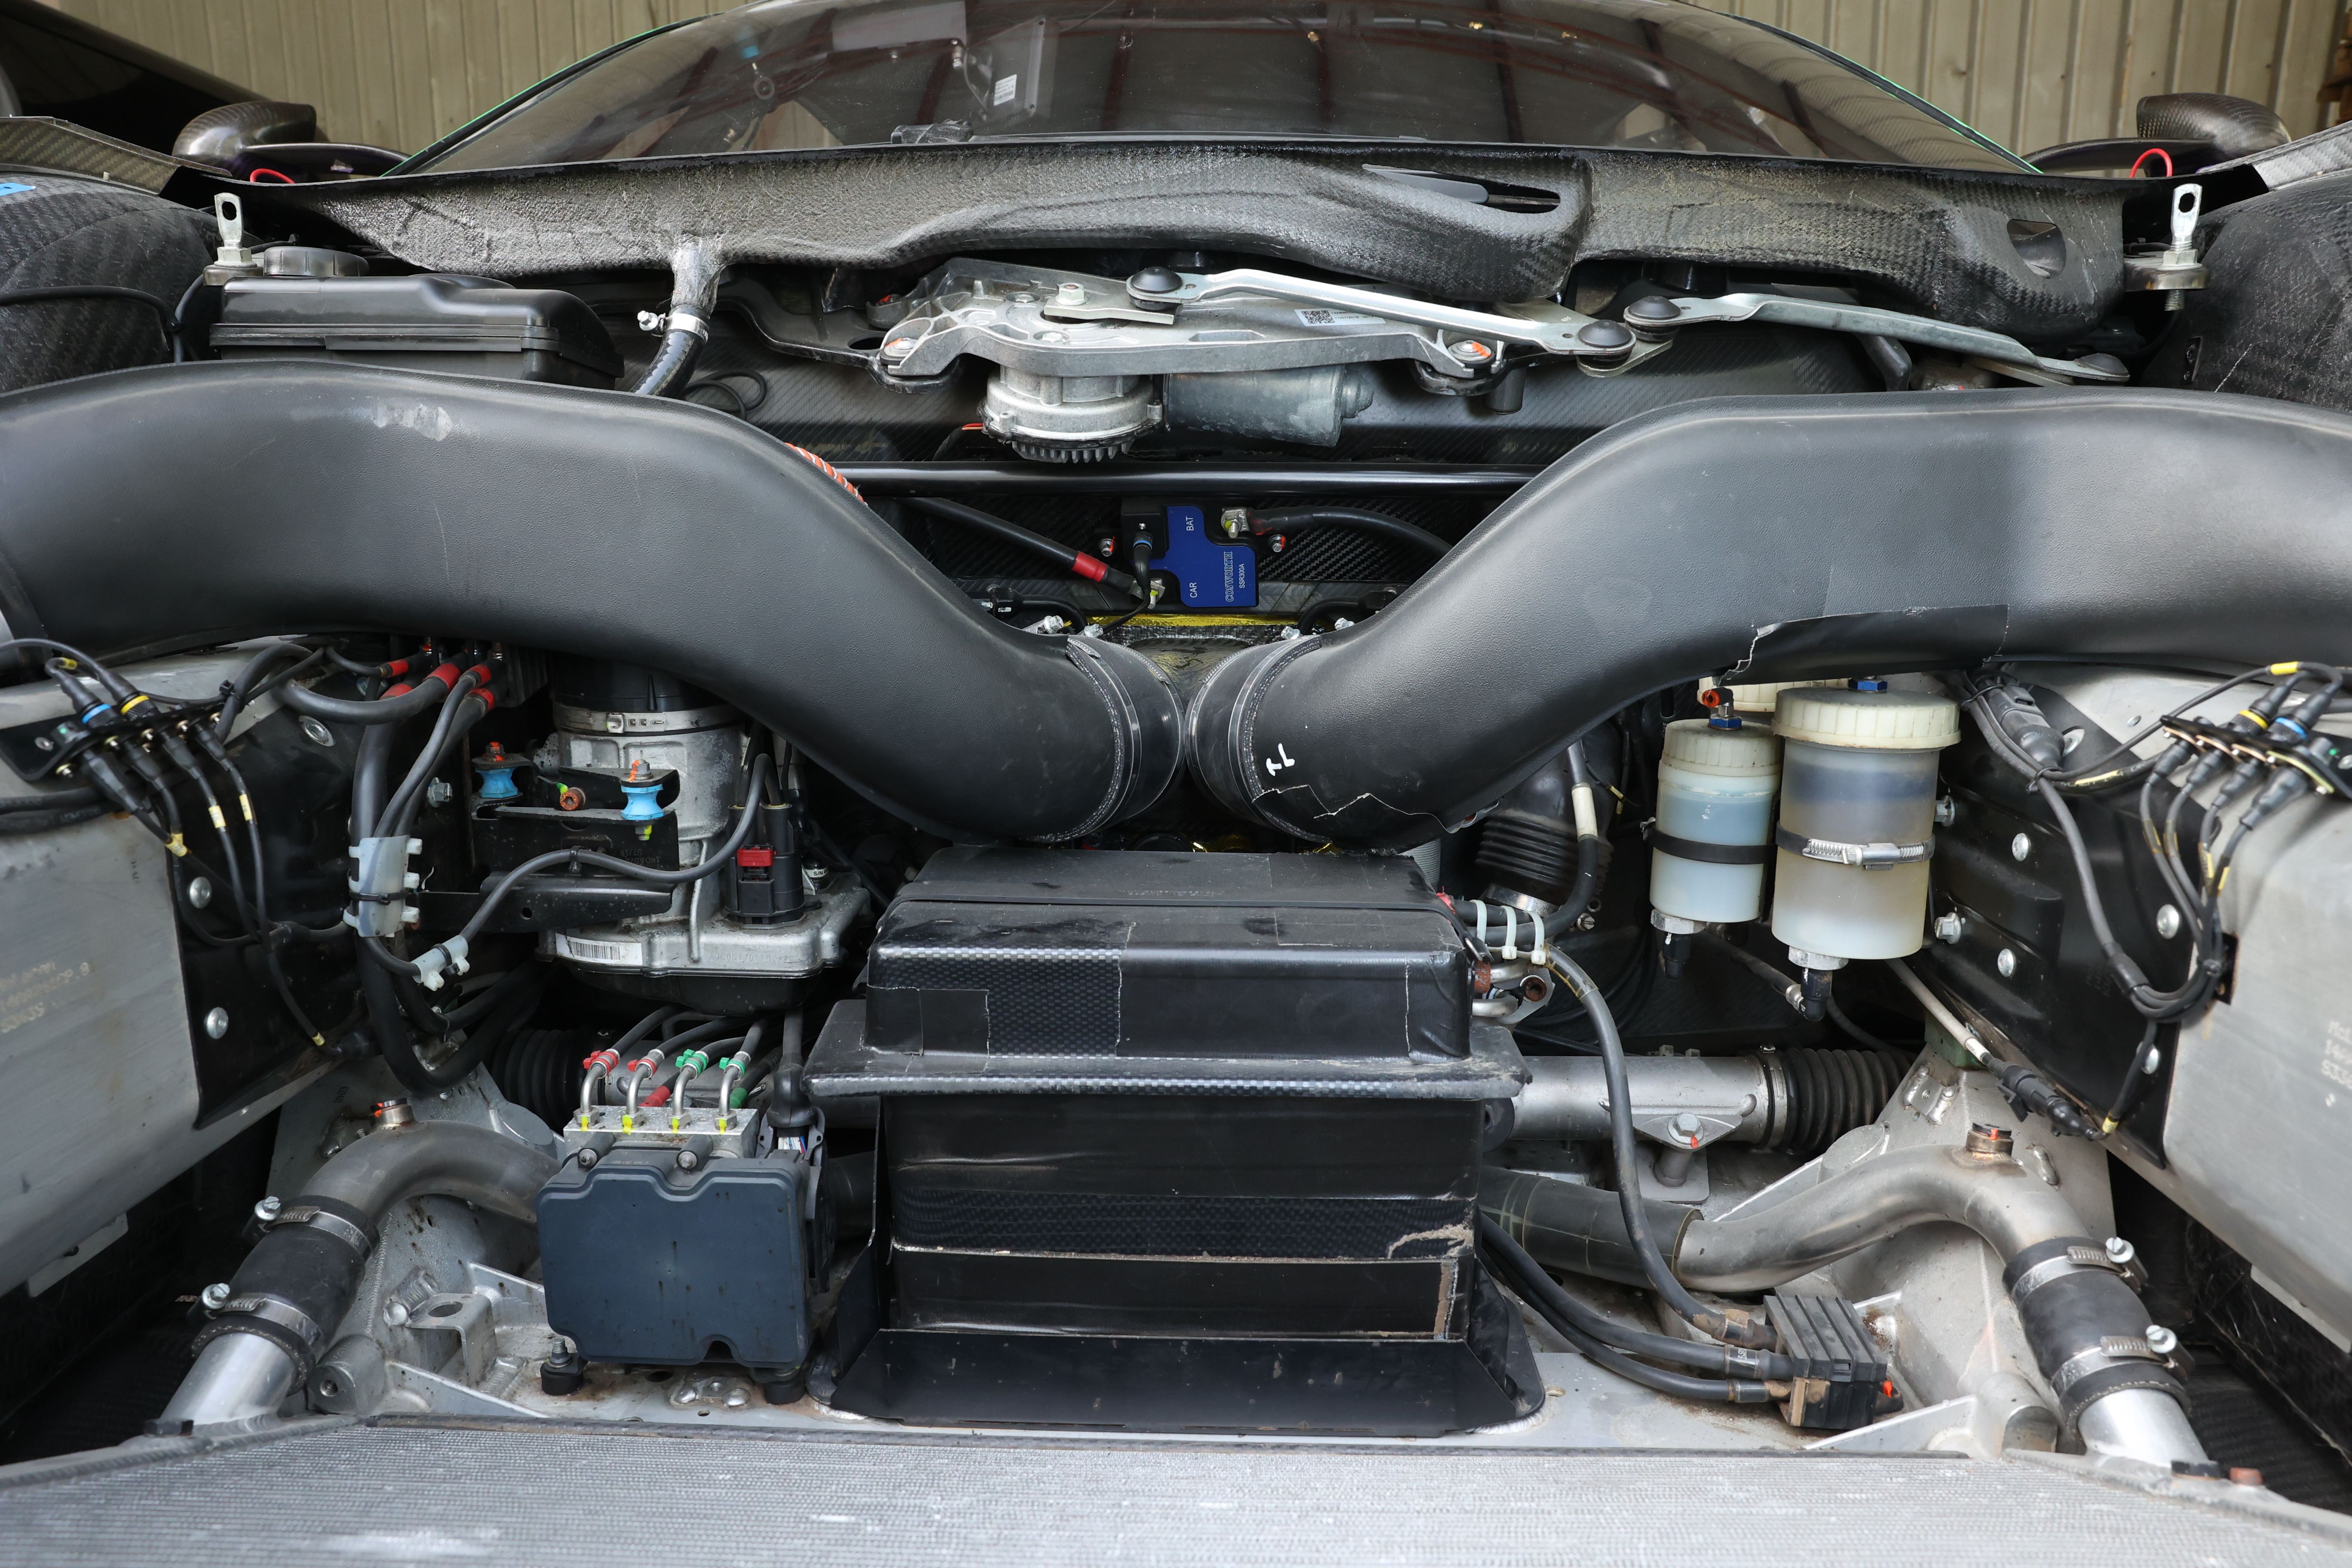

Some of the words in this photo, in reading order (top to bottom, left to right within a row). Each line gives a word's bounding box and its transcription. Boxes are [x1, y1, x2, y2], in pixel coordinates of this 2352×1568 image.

[1186, 516, 1194, 531] BAT
[1224, 551, 1234, 602] COSWORTH
[1189, 582, 1197, 598] CAR
